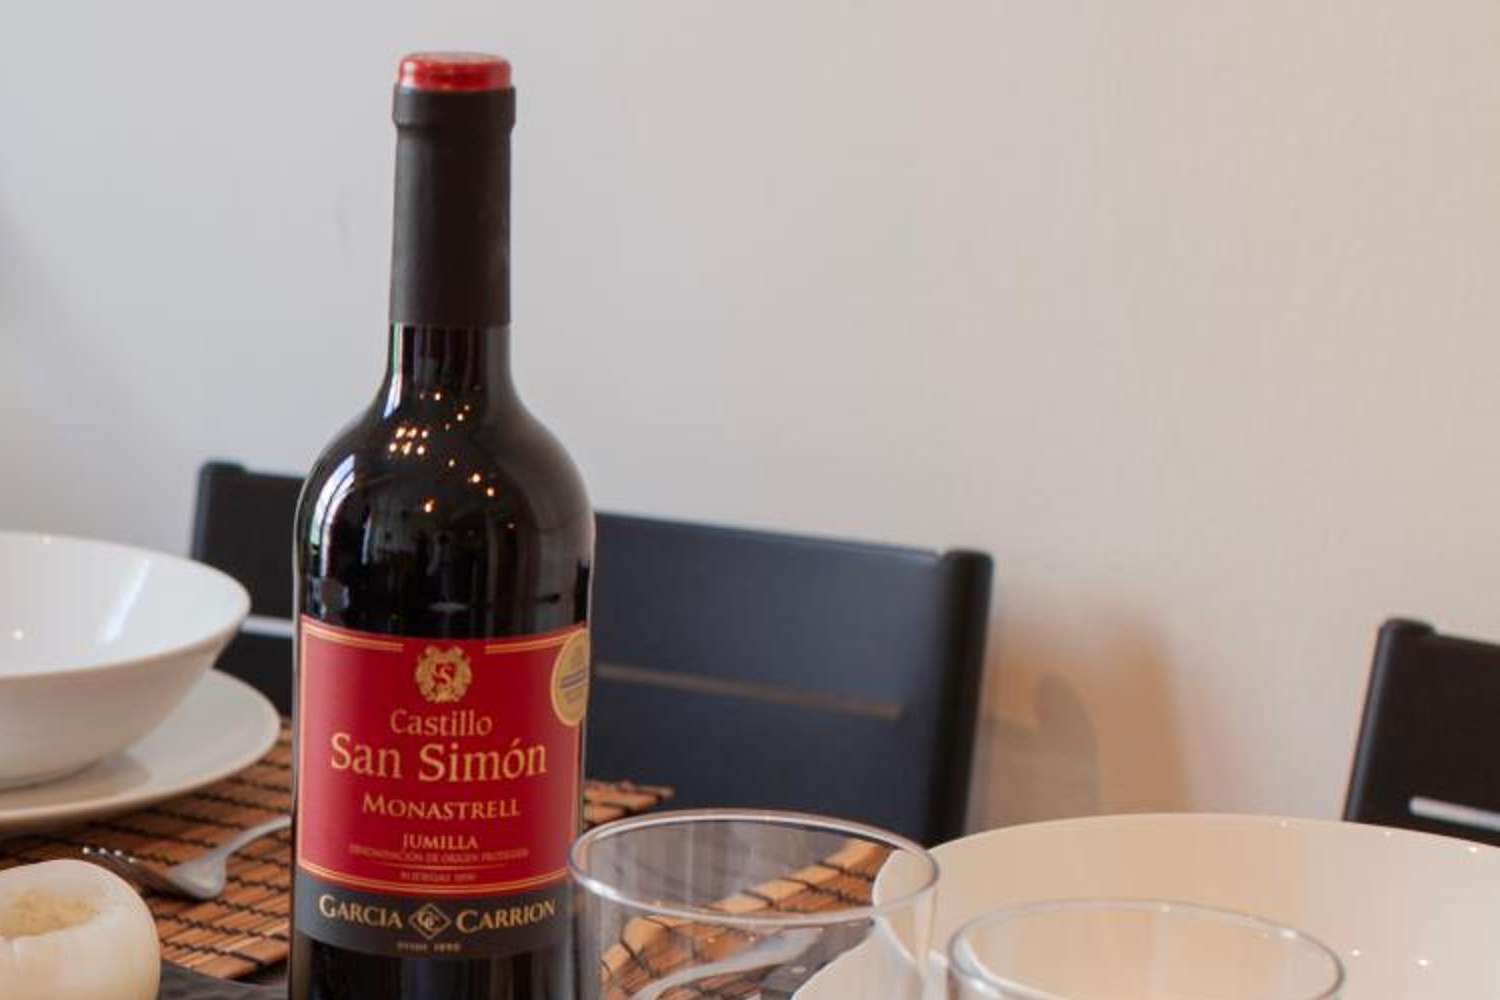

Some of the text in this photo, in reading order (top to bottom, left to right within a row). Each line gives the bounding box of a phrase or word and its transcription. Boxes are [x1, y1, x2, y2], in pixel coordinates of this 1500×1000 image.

[390, 709, 493, 736] Castillo
[330, 732, 548, 783] San Simón
[362, 792, 521, 821] MONASTRELL
[402, 833, 479, 850] JUMILLA
[318, 894, 403, 929] GARCIA
[455, 899, 557, 934] CARRION
